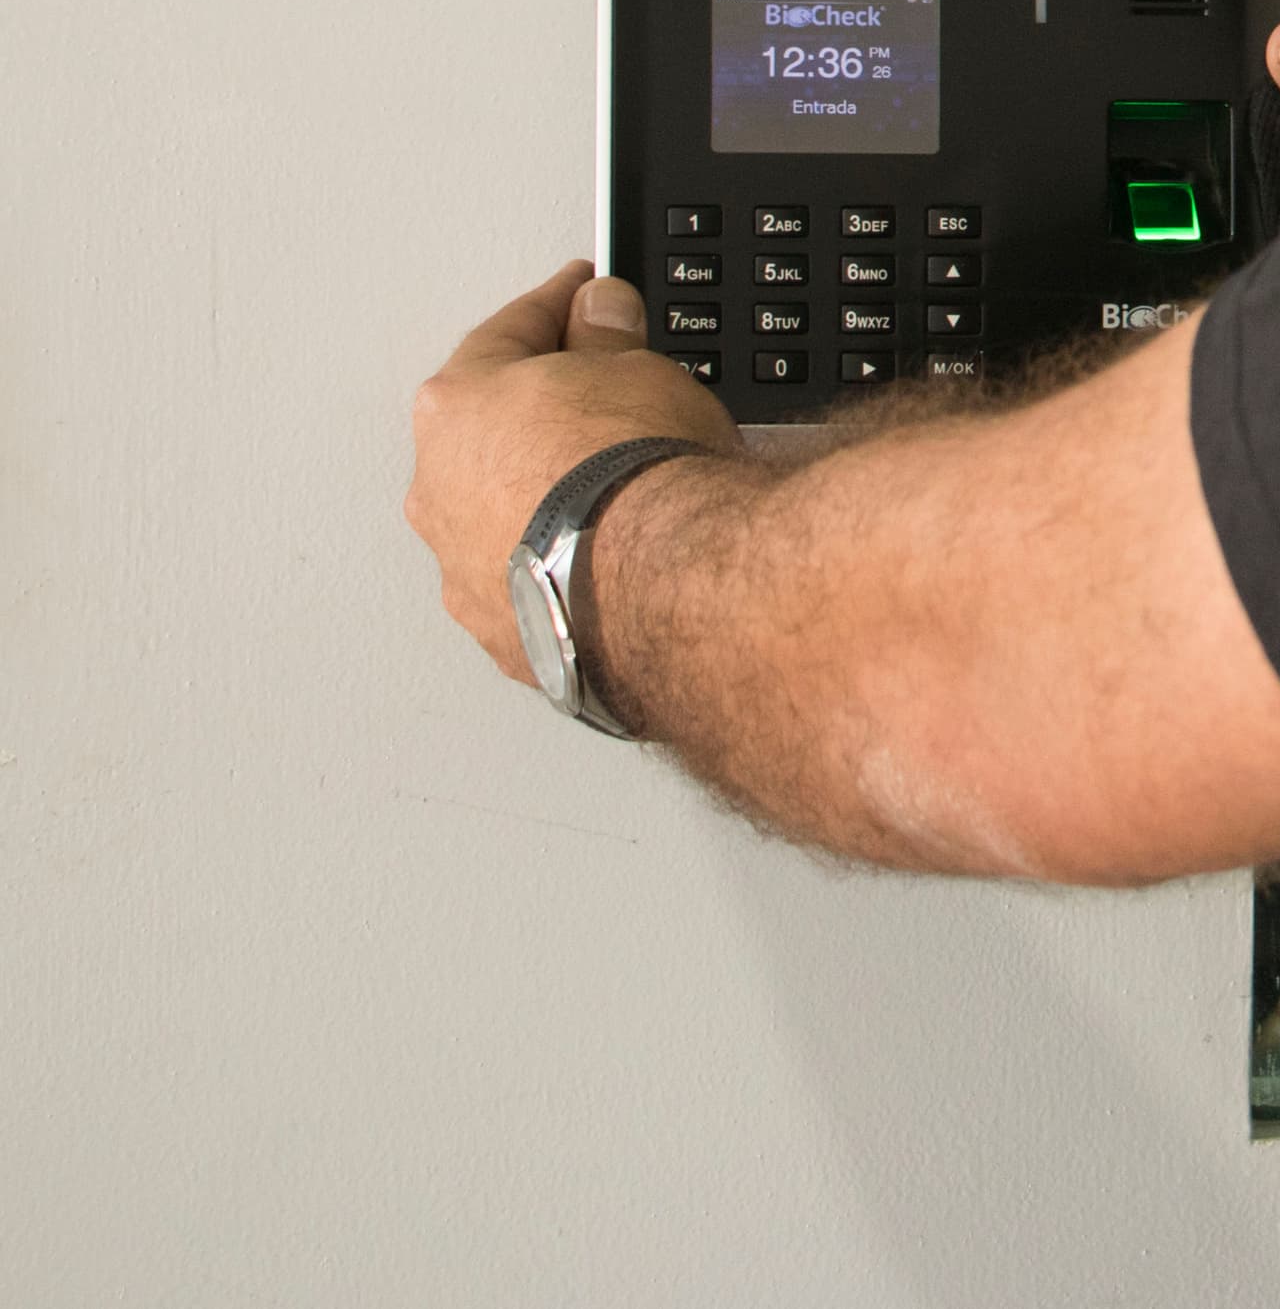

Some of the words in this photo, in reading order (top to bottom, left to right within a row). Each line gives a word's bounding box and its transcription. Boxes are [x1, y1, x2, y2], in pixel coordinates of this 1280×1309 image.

[762, 46, 863, 79] 12:36
[869, 47, 890, 59] PM
[872, 66, 891, 79] 26
[792, 99, 857, 115] Entrada
[689, 214, 699, 232] 1
[939, 217, 968, 230] ESC
[775, 359, 787, 376] 0
[934, 362, 974, 375] M/OK
